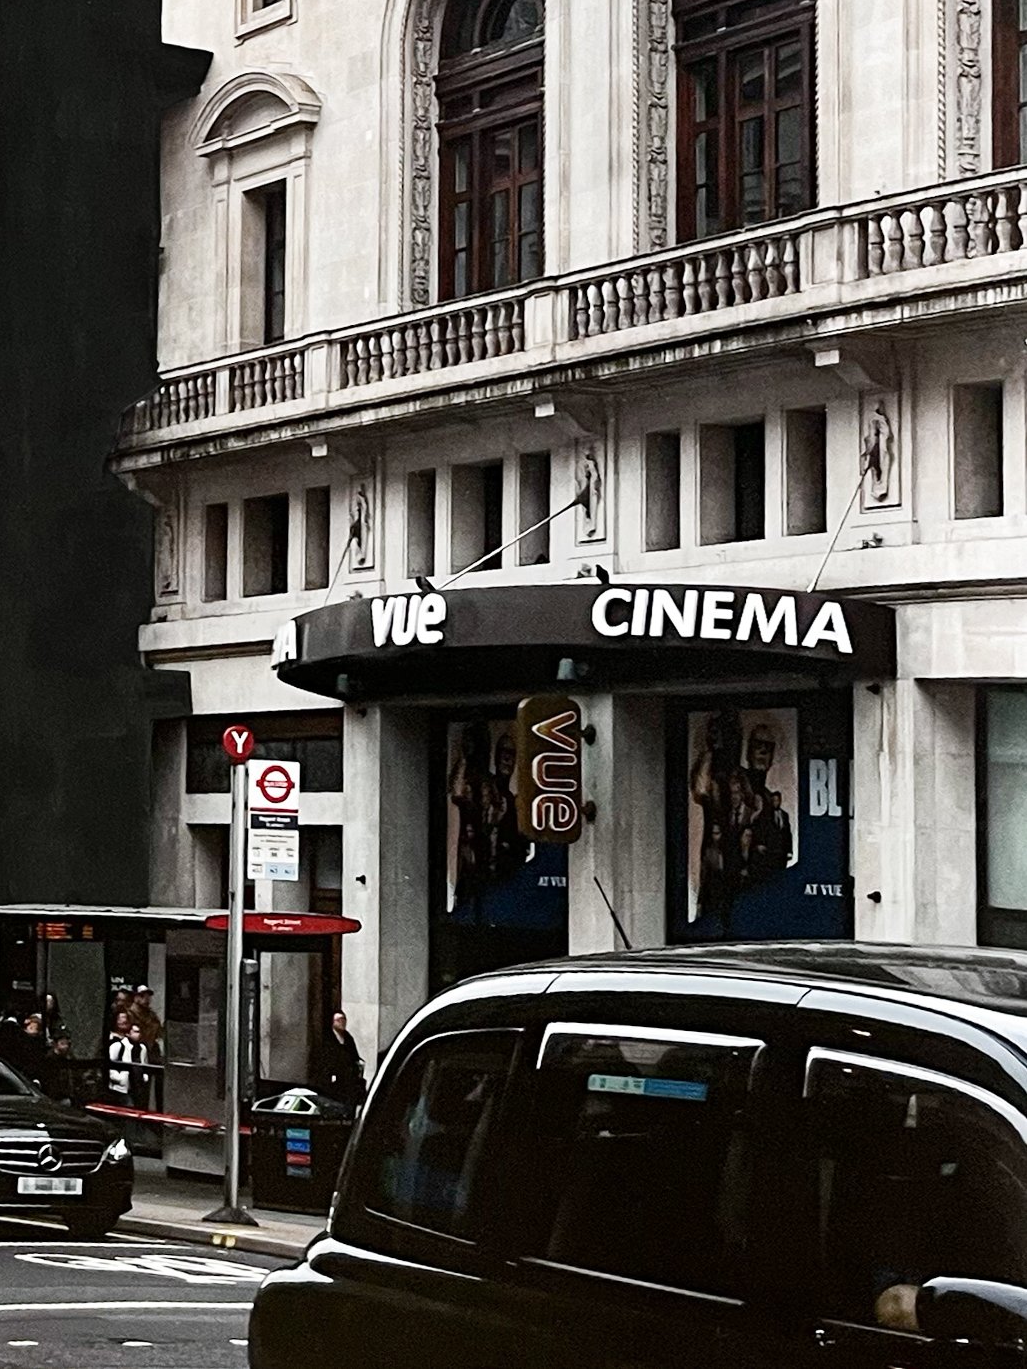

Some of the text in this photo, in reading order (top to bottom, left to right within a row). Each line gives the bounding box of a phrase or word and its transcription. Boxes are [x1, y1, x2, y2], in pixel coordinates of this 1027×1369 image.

[591, 588, 853, 654] CINEMA
[231, 731, 249, 753] Y
[809, 758, 854, 817] BL
[804, 884, 843, 897] AT VUE
